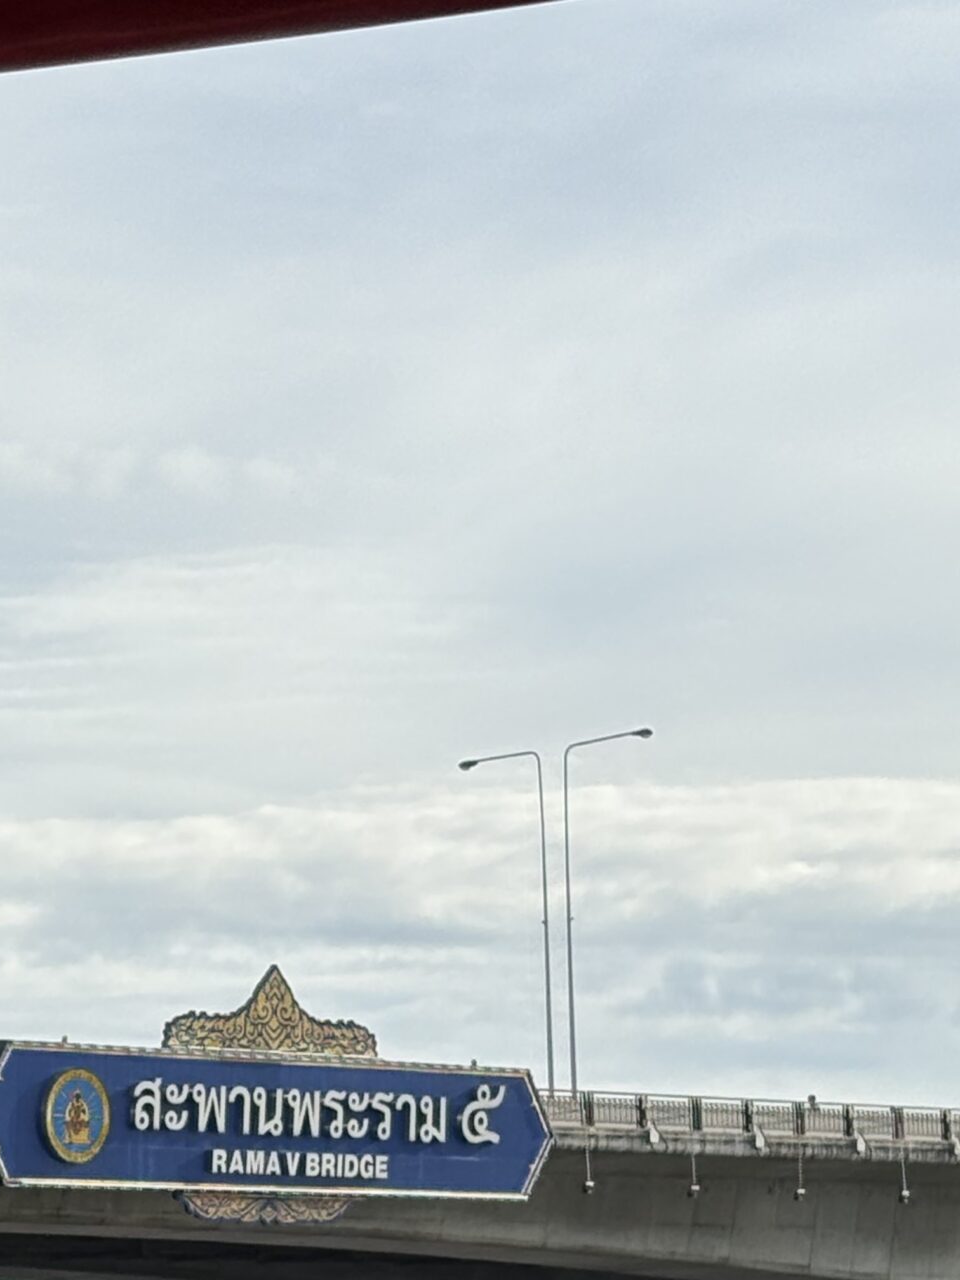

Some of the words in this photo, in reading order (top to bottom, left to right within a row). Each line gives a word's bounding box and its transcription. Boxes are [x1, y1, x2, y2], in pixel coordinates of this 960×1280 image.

[133, 1077, 447, 1143] สะพานพระราม
[461, 1084, 506, 1144] ๕
[211, 1149, 281, 1176] RAMA
[286, 1151, 300, 1177] V
[305, 1152, 388, 1179] BRIDGE
